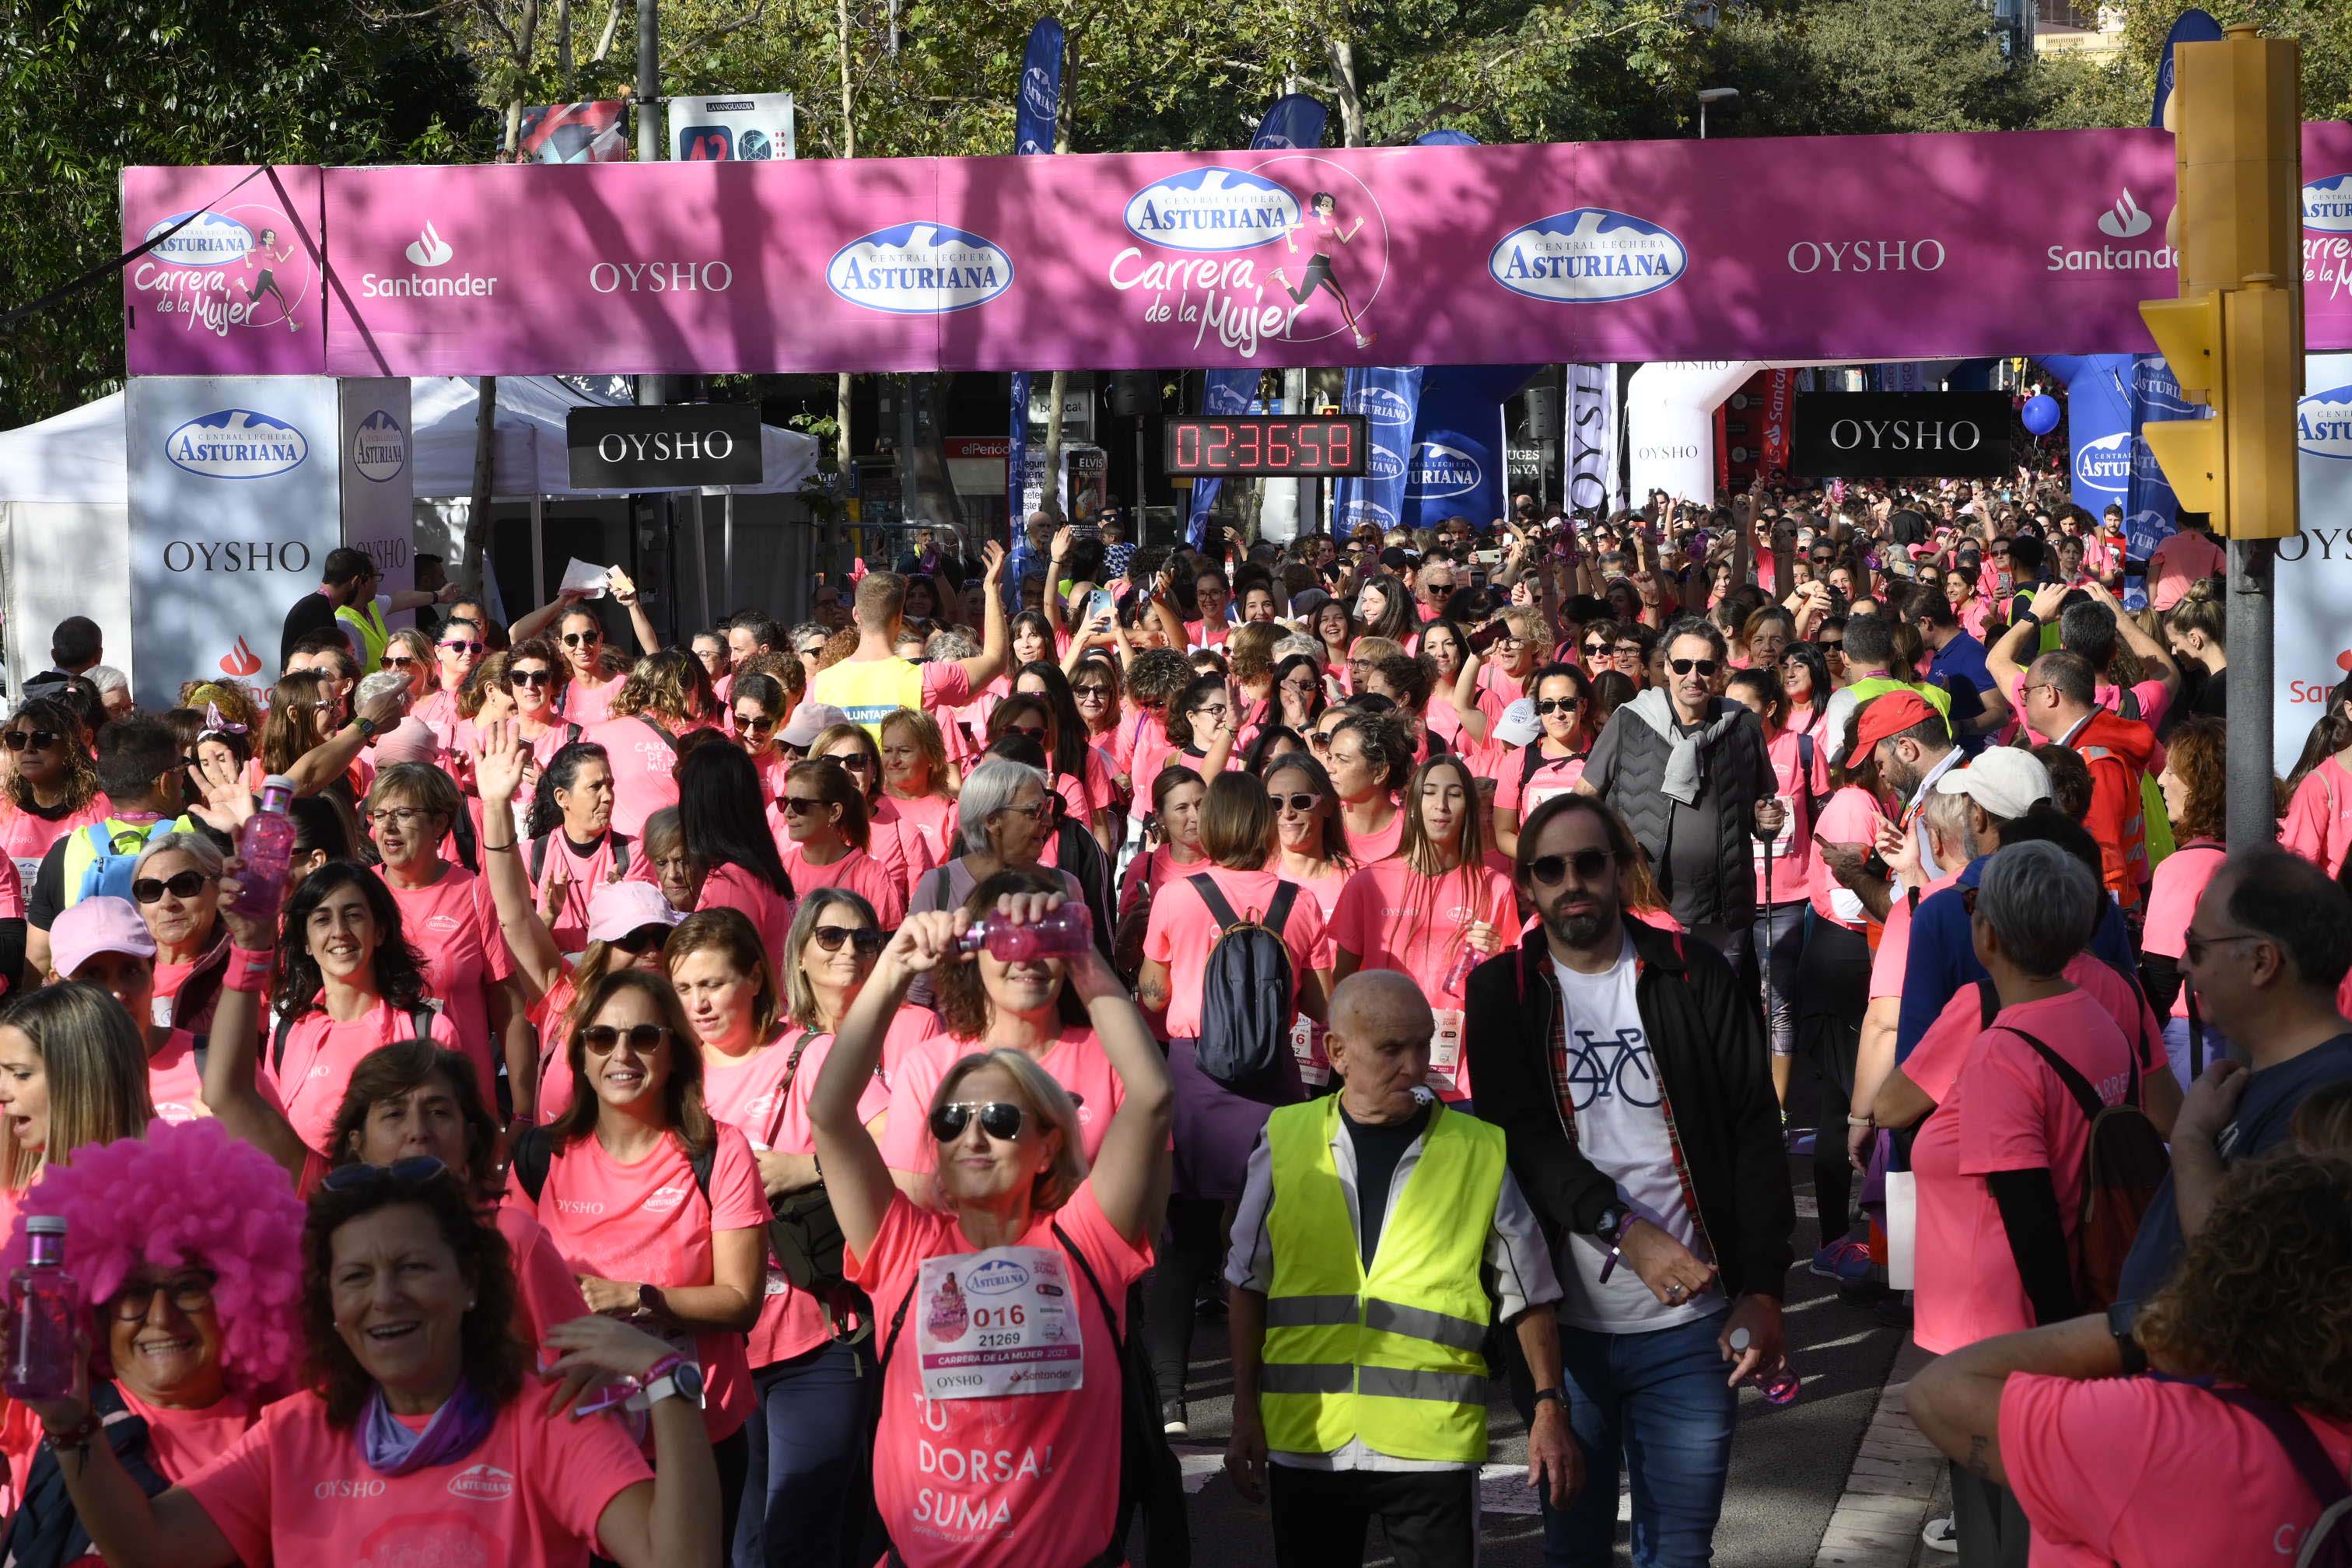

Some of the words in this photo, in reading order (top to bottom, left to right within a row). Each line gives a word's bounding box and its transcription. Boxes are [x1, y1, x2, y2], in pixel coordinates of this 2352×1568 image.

[1226, 195, 1282, 205] LECHERA
[1138, 199, 1287, 230] ASTURIANA
[1535, 241, 1599, 251] CENTRAL
[1602, 239, 1665, 250] LECHERA
[1788, 239, 1945, 274] OYSHO
[870, 254, 926, 263] CENTRAL
[1108, 247, 1255, 290] Carrera
[1504, 244, 1672, 280] ASTURIANA
[134, 262, 226, 291] Carrera
[590, 261, 733, 293] OYSHO
[842, 256, 999, 290] ASTURIANA
[2319, 261, 2333, 282] la
[362, 273, 498, 297] Santander
[157, 293, 174, 313] de
[177, 292, 190, 313] la
[187, 289, 261, 337] Mujer
[1145, 293, 1172, 323] de
[1178, 291, 1197, 323] la
[1193, 285, 1309, 359] Mujer
[1177, 425, 1350, 467] 02:36:58
[1830, 418, 1981, 450] OYSHO
[177, 435, 298, 462] ASTURIANA
[357, 441, 403, 465] ASTURIANA
[598, 430, 733, 463] OYSHO
[1639, 444, 1699, 462] OYSHO
[1079, 458, 1103, 468] ELVIS
[163, 541, 311, 573] OYSHO
[554, 1199, 604, 1215] OYSHO
[971, 1273, 1024, 1290] ASTURIANA
[973, 1304, 1025, 1328] 016
[978, 1332, 1020, 1347] 21269
[938, 1354, 982, 1366] CARRERA
[982, 1353, 996, 1362] DE
[998, 1352, 1010, 1361] LA
[1012, 1349, 1044, 1360] MUJER
[937, 1374, 983, 1388] OYSHO
[1022, 1369, 1072, 1381] Santander
[314, 1479, 387, 1502] OYSHO
[913, 1487, 1013, 1531] SUMA
